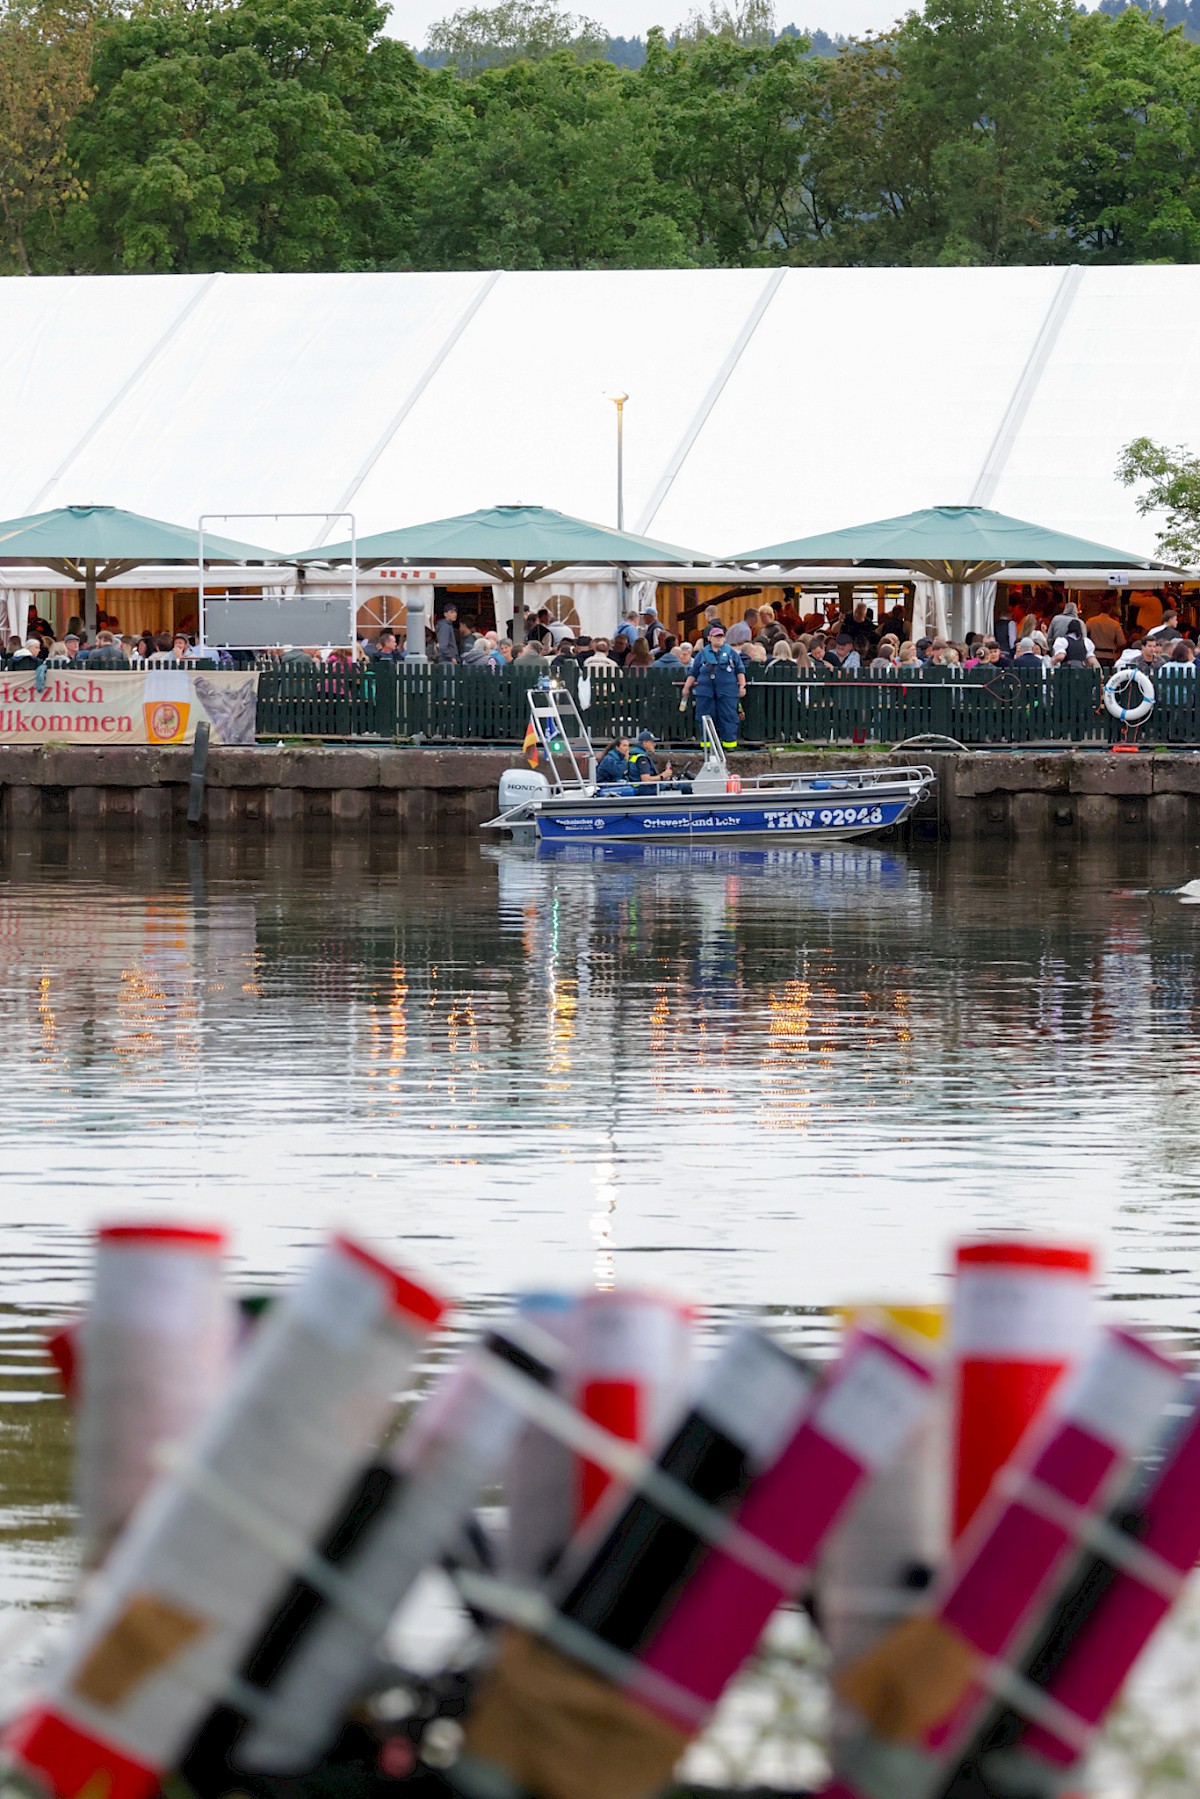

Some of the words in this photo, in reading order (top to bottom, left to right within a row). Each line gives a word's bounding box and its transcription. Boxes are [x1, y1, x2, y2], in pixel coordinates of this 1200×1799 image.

[0, 680, 104, 703] Herzlich
[507, 783, 542, 791] HONDA
[763, 811, 815, 828] THW
[820, 806, 883, 827] 92948
